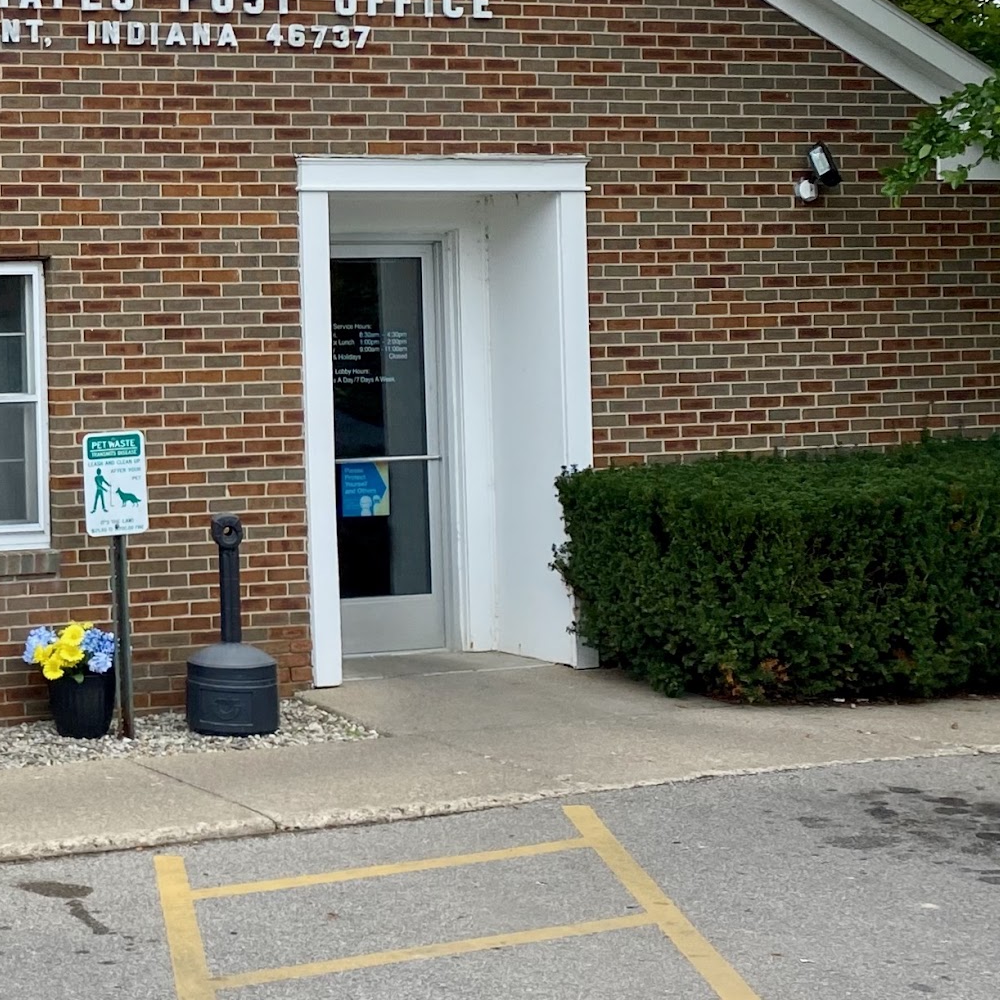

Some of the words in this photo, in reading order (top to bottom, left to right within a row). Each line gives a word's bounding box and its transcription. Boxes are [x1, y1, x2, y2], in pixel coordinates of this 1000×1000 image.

[87, 20, 238, 47] INDIANA
[266, 23, 371, 49] 46737
[91, 441, 107, 449] PET
[108, 439, 135, 449] WASTE
